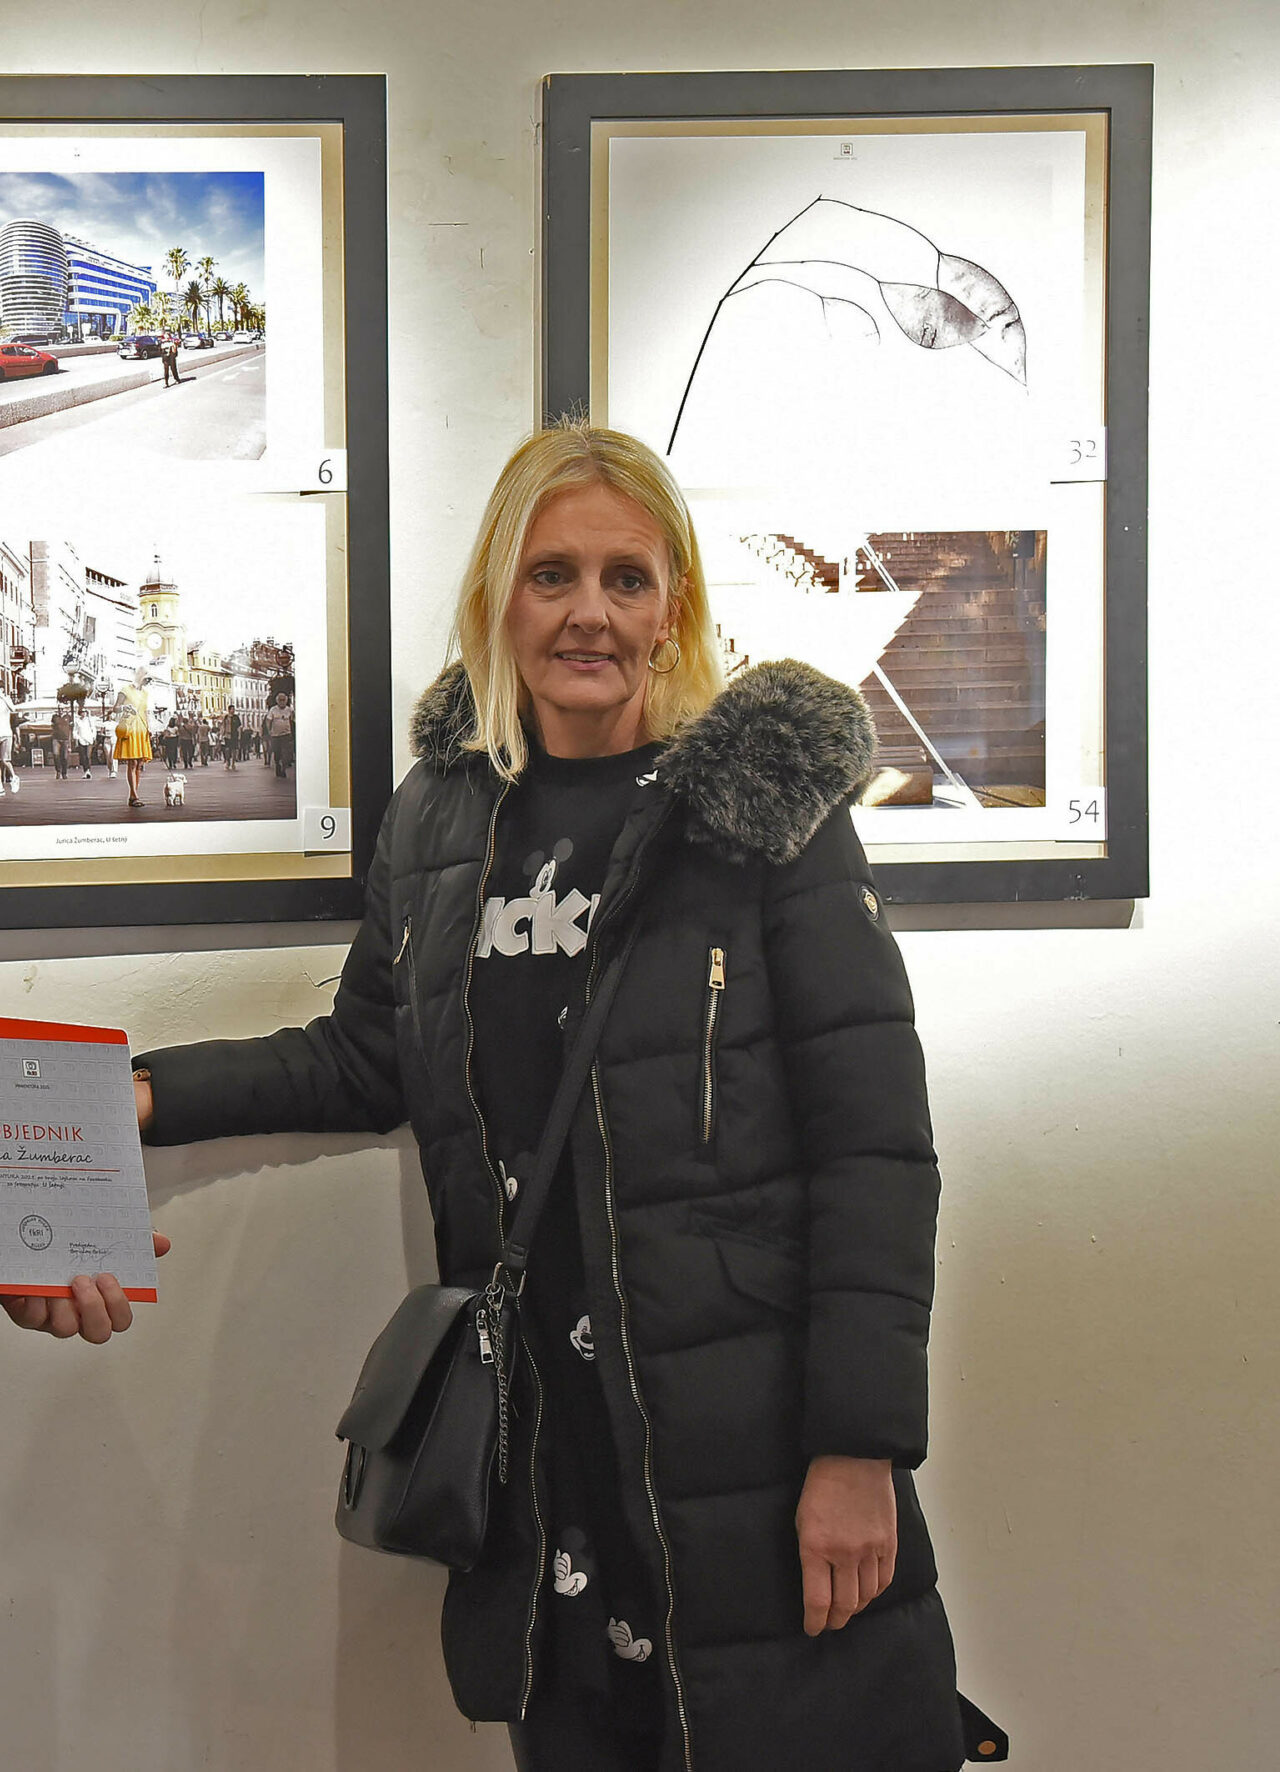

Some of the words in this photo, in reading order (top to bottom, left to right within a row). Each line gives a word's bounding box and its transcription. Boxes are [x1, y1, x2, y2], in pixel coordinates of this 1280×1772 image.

[1070, 439, 1096, 464] 32
[318, 459, 333, 484] 6
[1069, 800, 1100, 824] 54
[320, 815, 336, 840] 9
[17, 1145, 93, 1164] Žumberac
